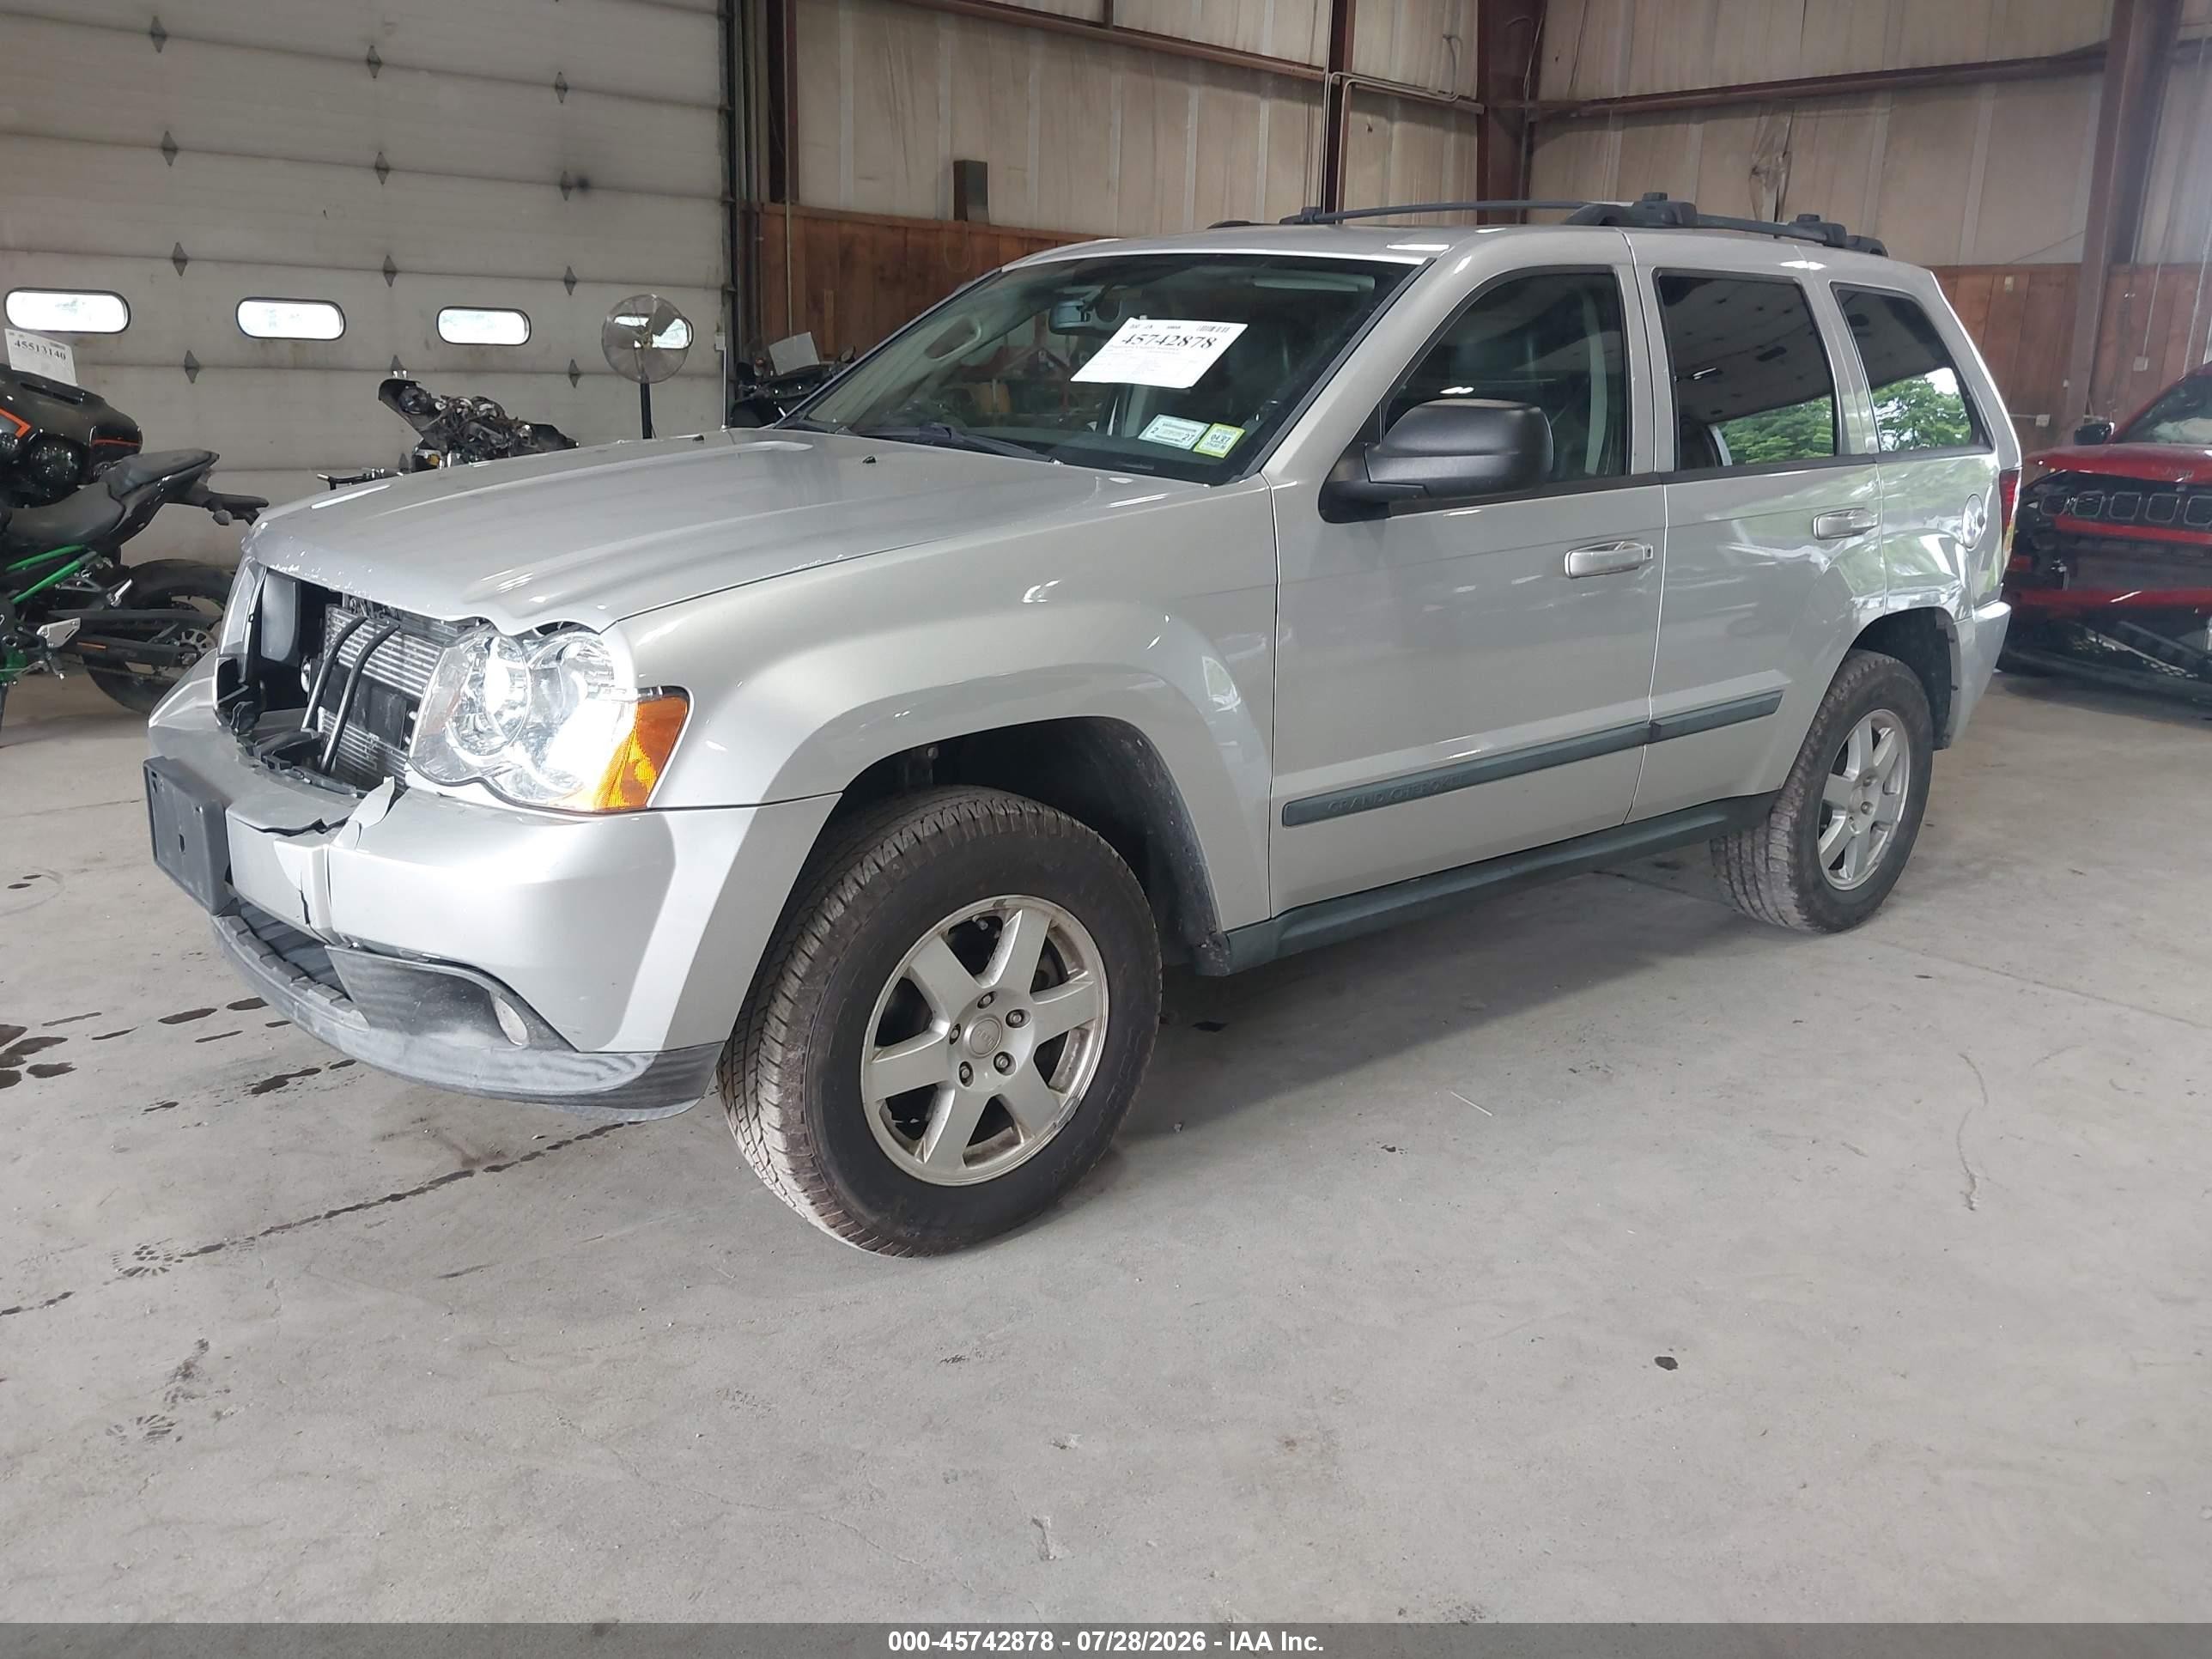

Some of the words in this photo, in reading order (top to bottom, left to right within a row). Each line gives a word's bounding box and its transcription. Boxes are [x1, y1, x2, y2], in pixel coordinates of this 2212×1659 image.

[15, 339, 66, 360] 45513140
[1122, 334, 1217, 349] 45742878
[1327, 793, 1384, 812] GRAND
